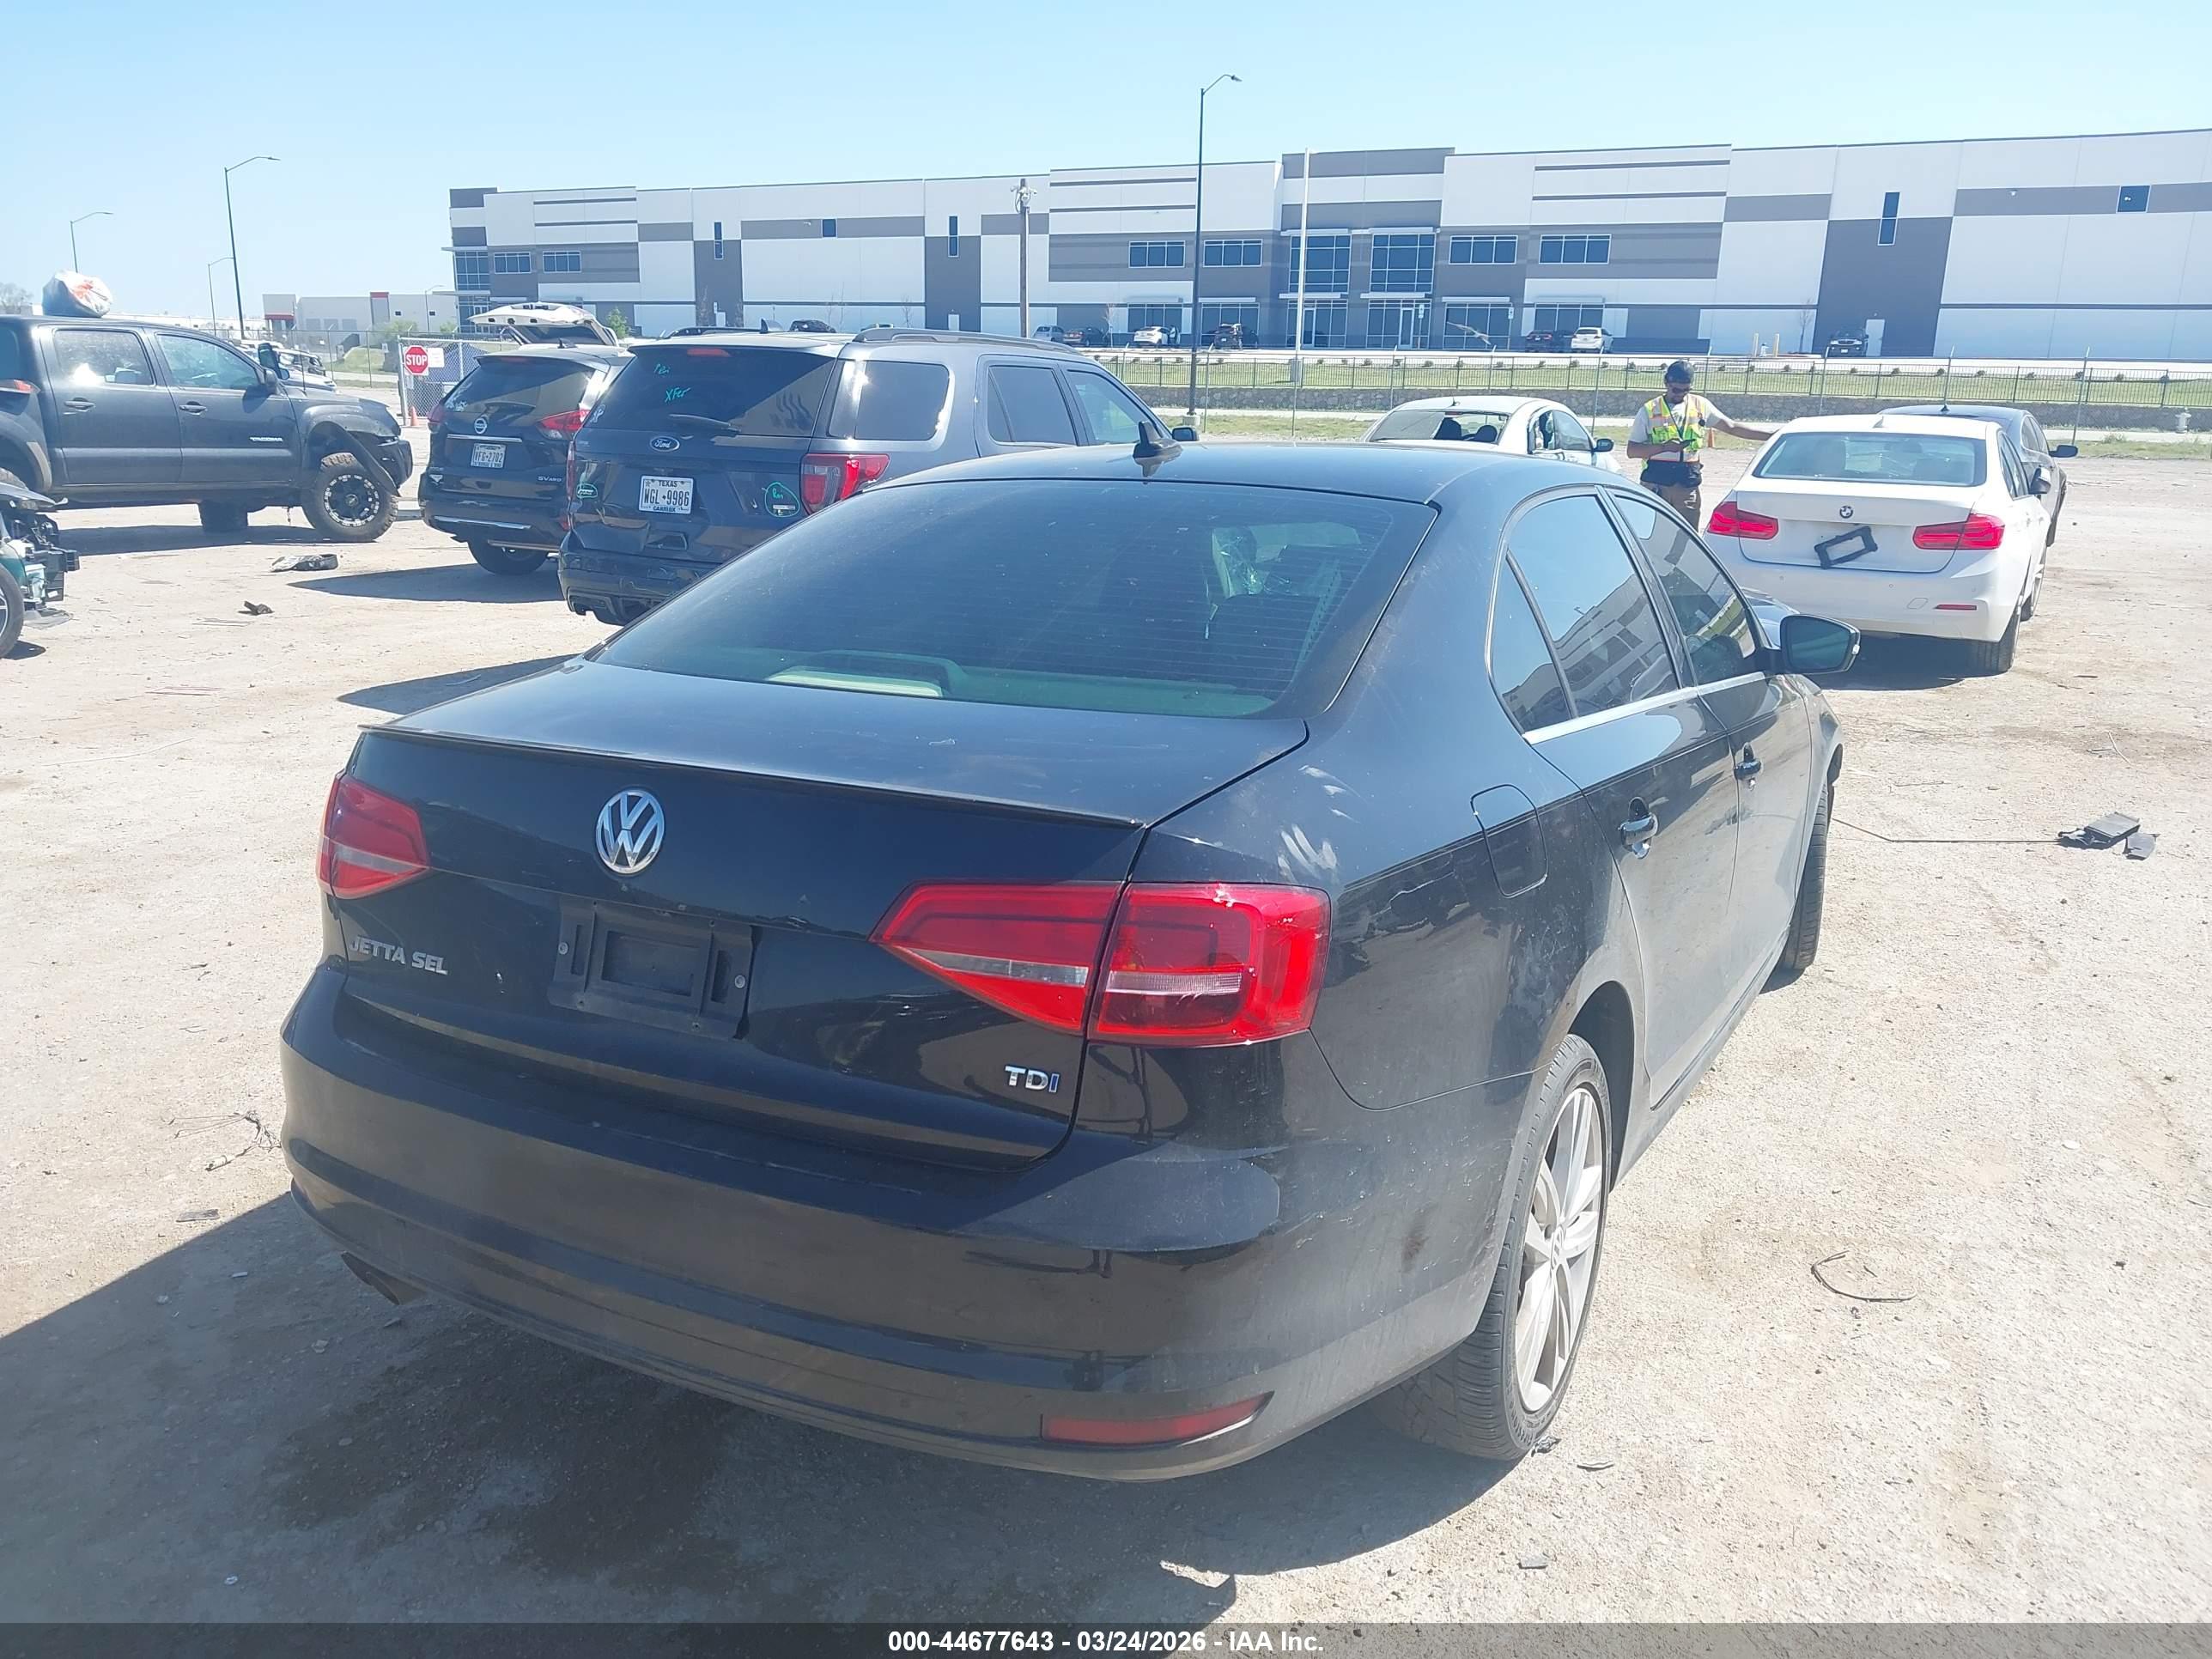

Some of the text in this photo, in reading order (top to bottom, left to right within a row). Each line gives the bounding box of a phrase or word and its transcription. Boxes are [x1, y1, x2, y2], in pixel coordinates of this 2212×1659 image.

[406, 354, 427, 366] STOP
[349, 935, 448, 975] JETTA SEL
[1005, 1065, 1060, 1093] TDI
